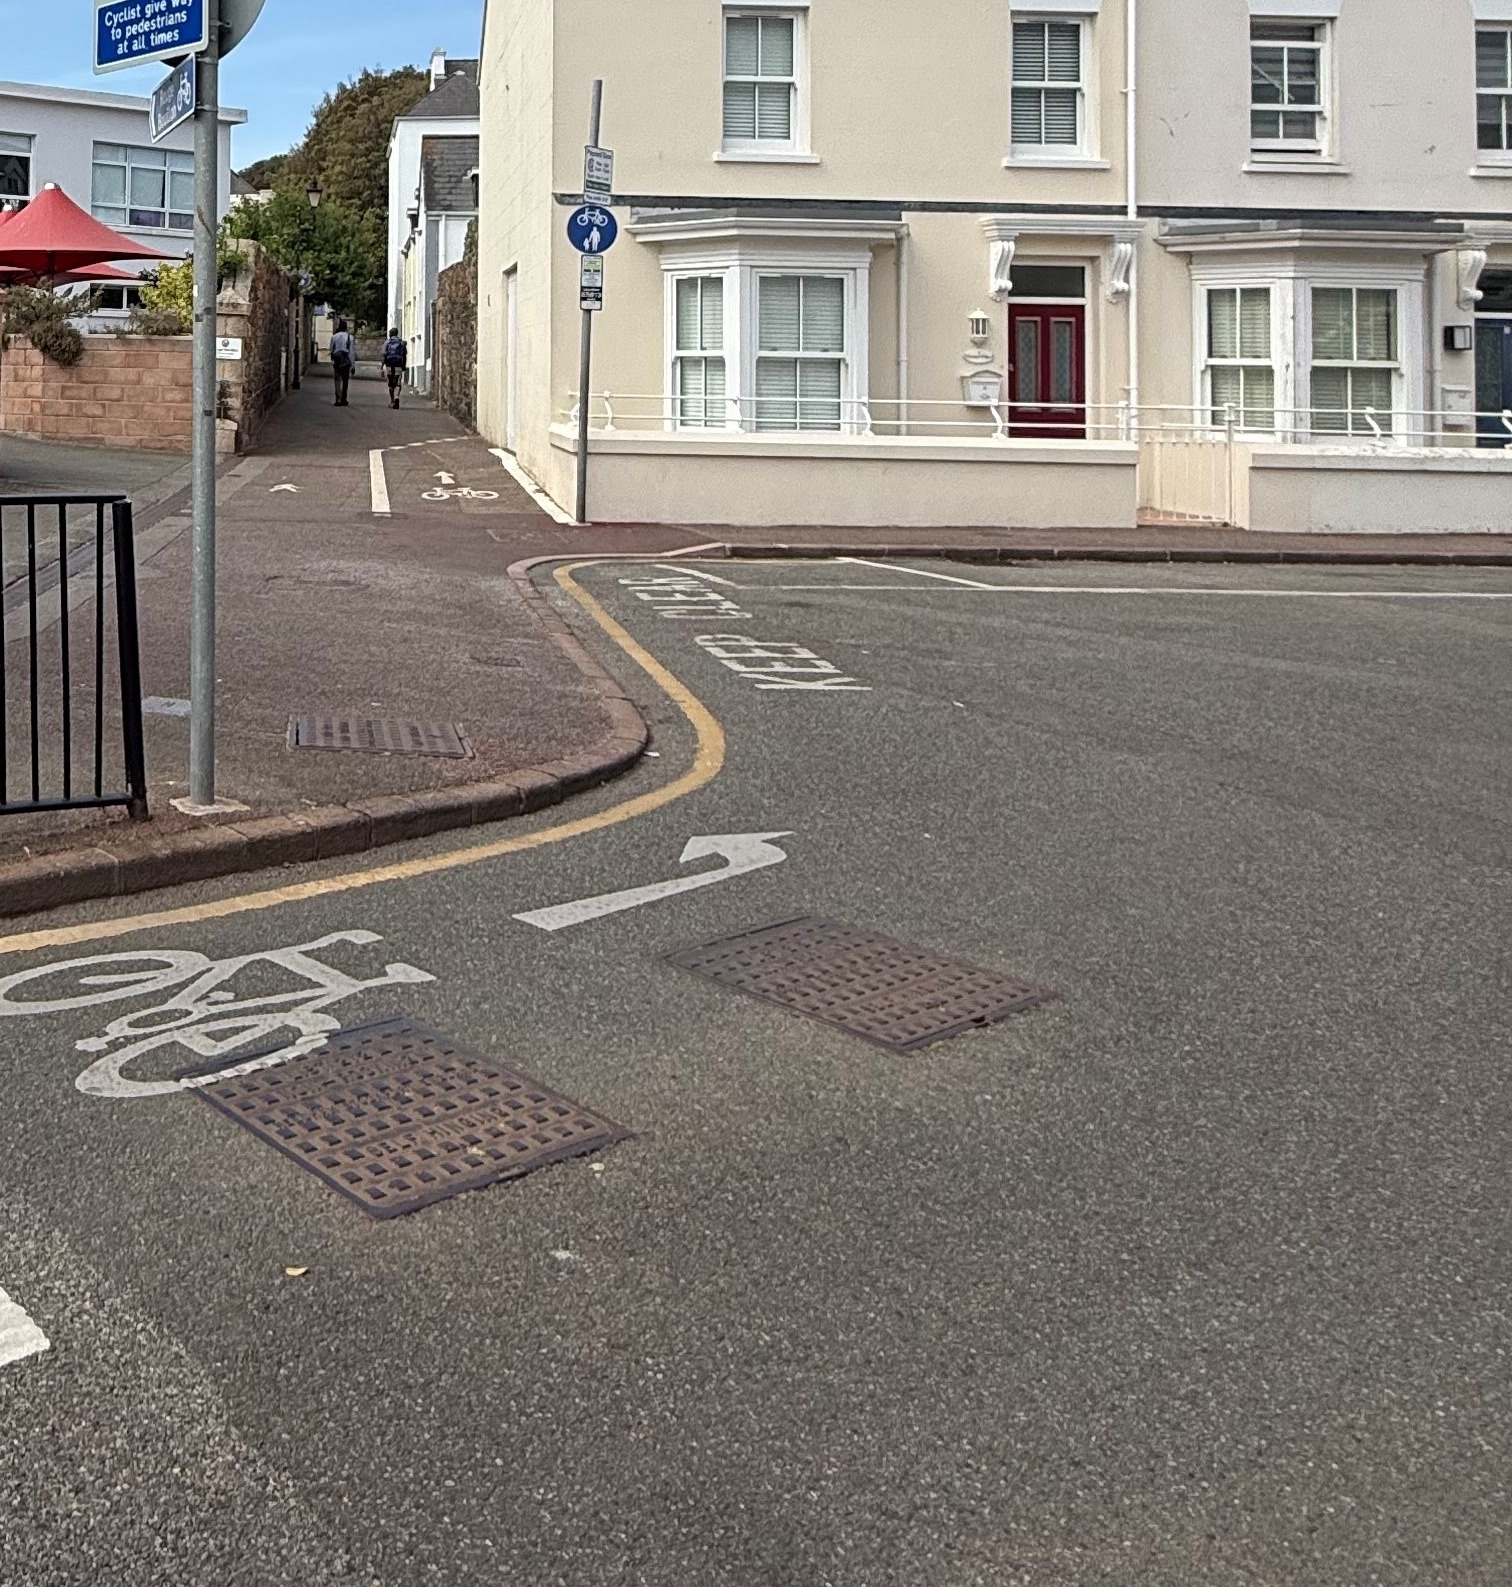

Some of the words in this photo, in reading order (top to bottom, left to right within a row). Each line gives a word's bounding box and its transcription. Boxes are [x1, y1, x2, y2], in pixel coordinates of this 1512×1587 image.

[105, 4, 141, 27] Cyclist
[145, 0, 167, 18] give
[111, 28, 122, 40] to
[125, 11, 187, 39] pedestrians
[117, 39, 128, 55] at
[132, 34, 146, 51] all
[150, 29, 179, 46] times
[618, 576, 753, 620] CLEAR
[694, 633, 873, 690] KEEP
